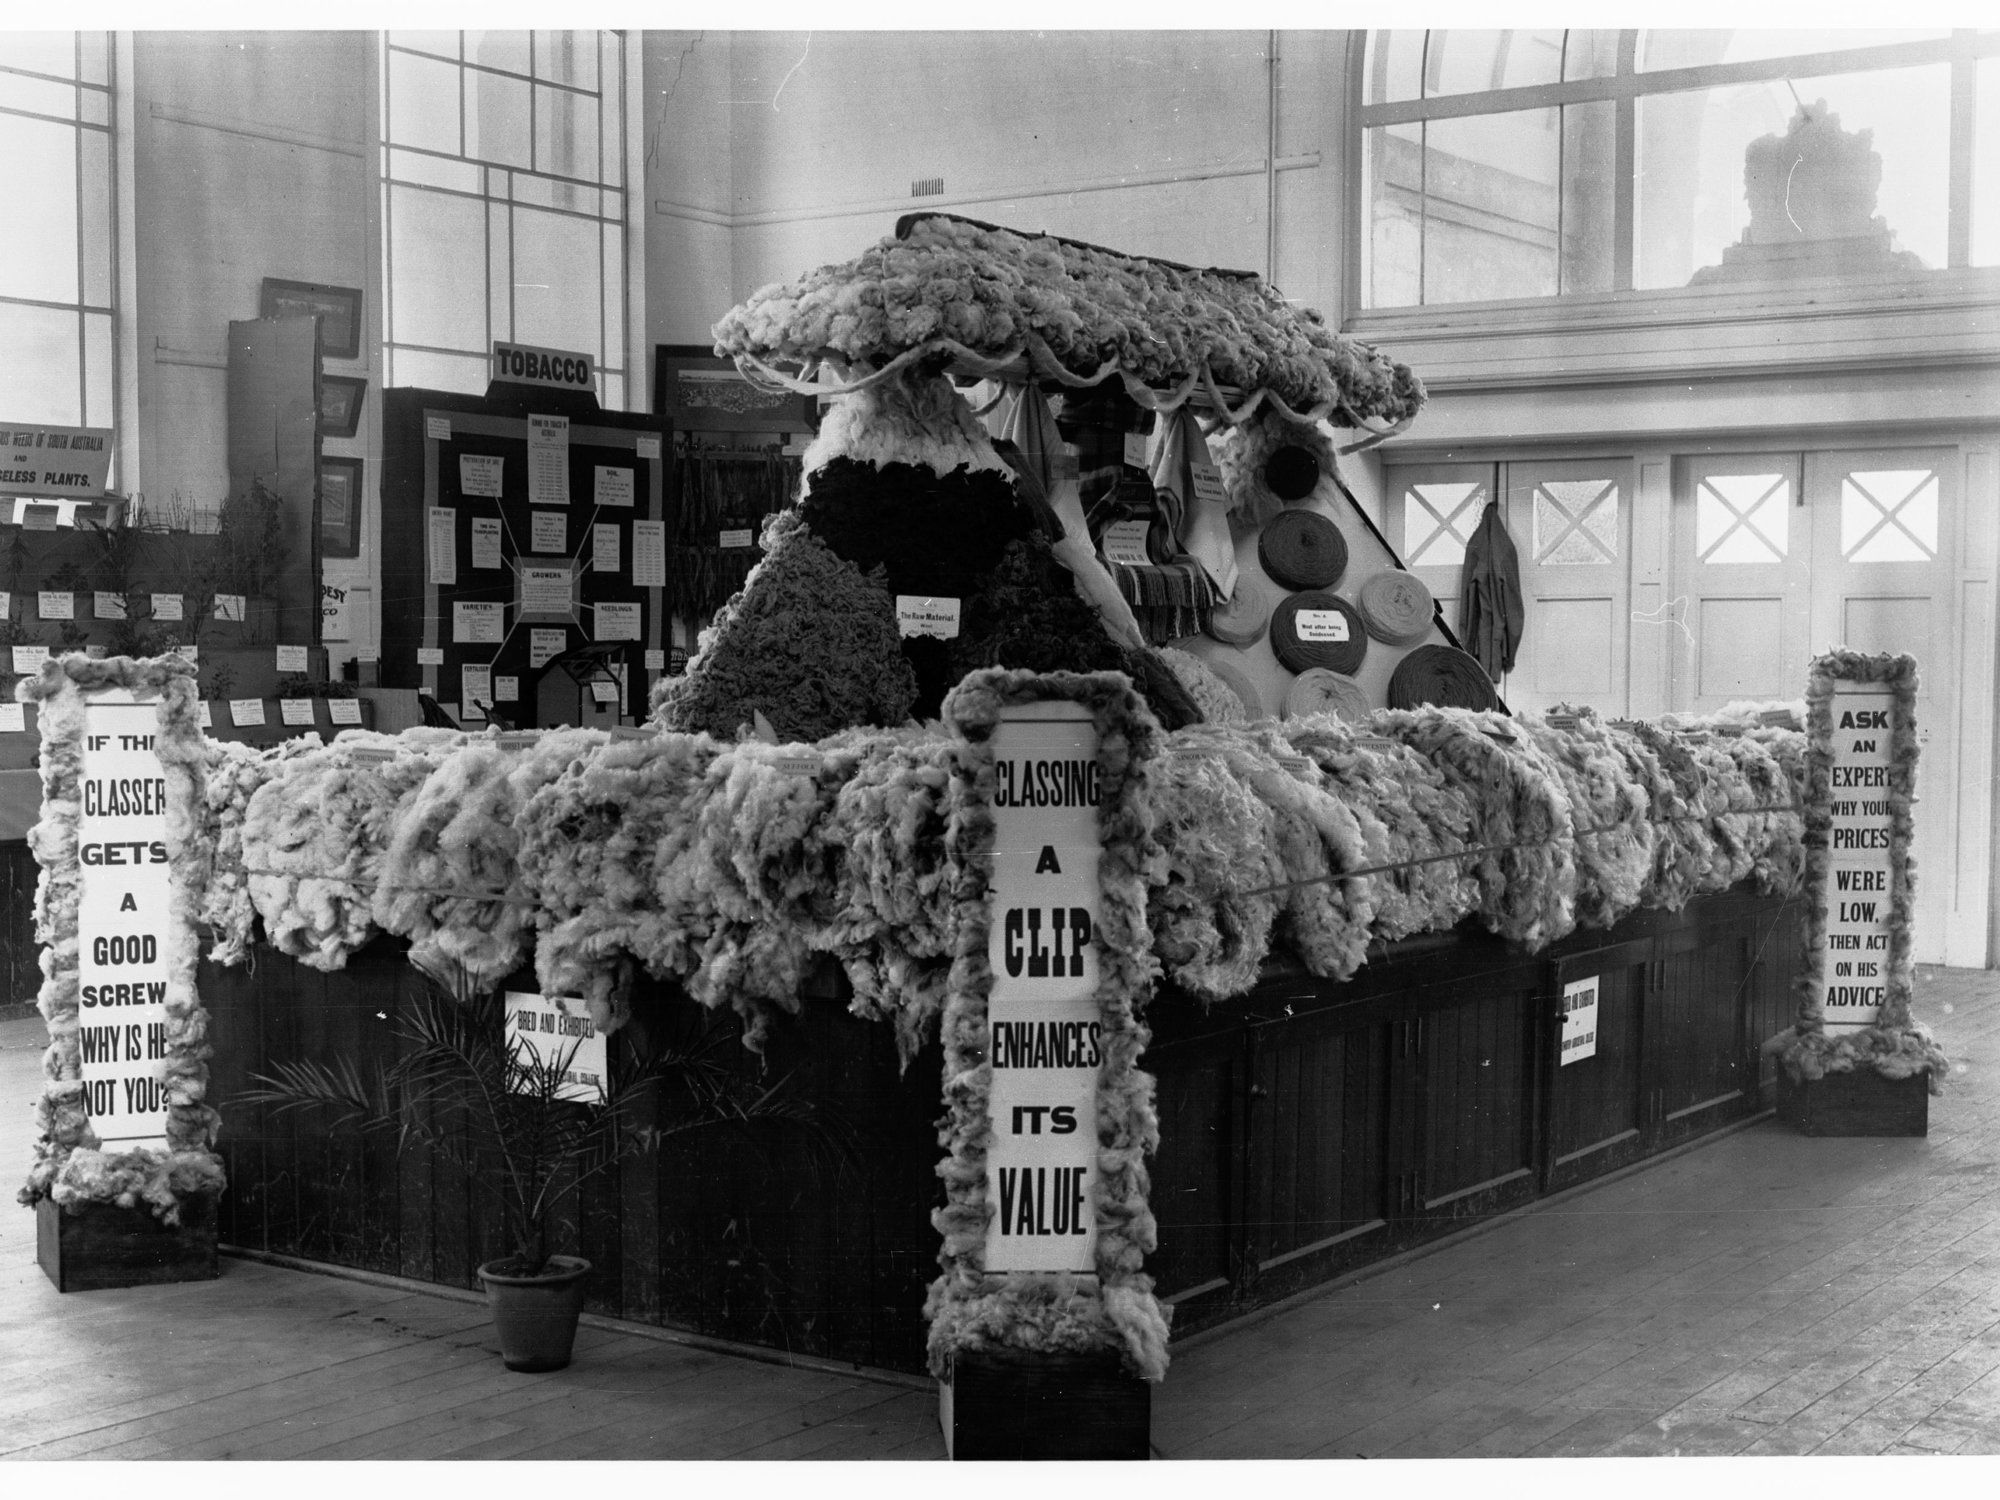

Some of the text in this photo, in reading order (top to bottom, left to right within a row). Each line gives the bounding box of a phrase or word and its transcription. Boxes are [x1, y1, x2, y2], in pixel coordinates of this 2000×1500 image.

[498, 348, 588, 385] TOBACCO
[13, 431, 34, 447] WEEDS
[36, 433, 45, 448] OF
[47, 434, 69, 449] SOUTH
[70, 435, 104, 452] AUSTRALIA
[44, 472, 91, 487] PLANTS.
[531, 571, 562, 579] GROWERS
[912, 612, 925, 620] Raw
[1839, 710, 1889, 730] ASK
[88, 735, 110, 751] IF
[1718, 728, 1742, 738] Merino
[1852, 740, 1876, 753] AN
[354, 753, 394, 763] SOUTHDOWN
[783, 762, 817, 770] SUFFOLK
[994, 760, 1100, 807] CLASSING
[85, 778, 166, 816] CLASSER
[1831, 800, 1858, 816] WHY
[1833, 828, 1890, 849] PRICES
[80, 841, 169, 865] GETS
[1035, 845, 1061, 874] A
[1836, 870, 1886, 891] WERE
[119, 892, 138, 912] A
[1840, 902, 1879, 924] LOW.
[93, 934, 157, 966] GOOD
[1005, 908, 1091, 978] CLIP
[1828, 935, 1889, 950] THEN ACT
[1836, 962, 1878, 977] ON HIS
[82, 982, 167, 1008] SCREW
[1826, 986, 1885, 1007] ADVICE
[518, 1009, 595, 1039] BRED AND EXHIBITED
[80, 1025, 121, 1064] WHY
[125, 1024, 142, 1061] IS
[992, 1021, 1101, 1069] ENHANCES
[82, 1079, 117, 1117] NOT
[1012, 1106, 1077, 1135] ITS
[999, 1167, 1087, 1236] VALUE
